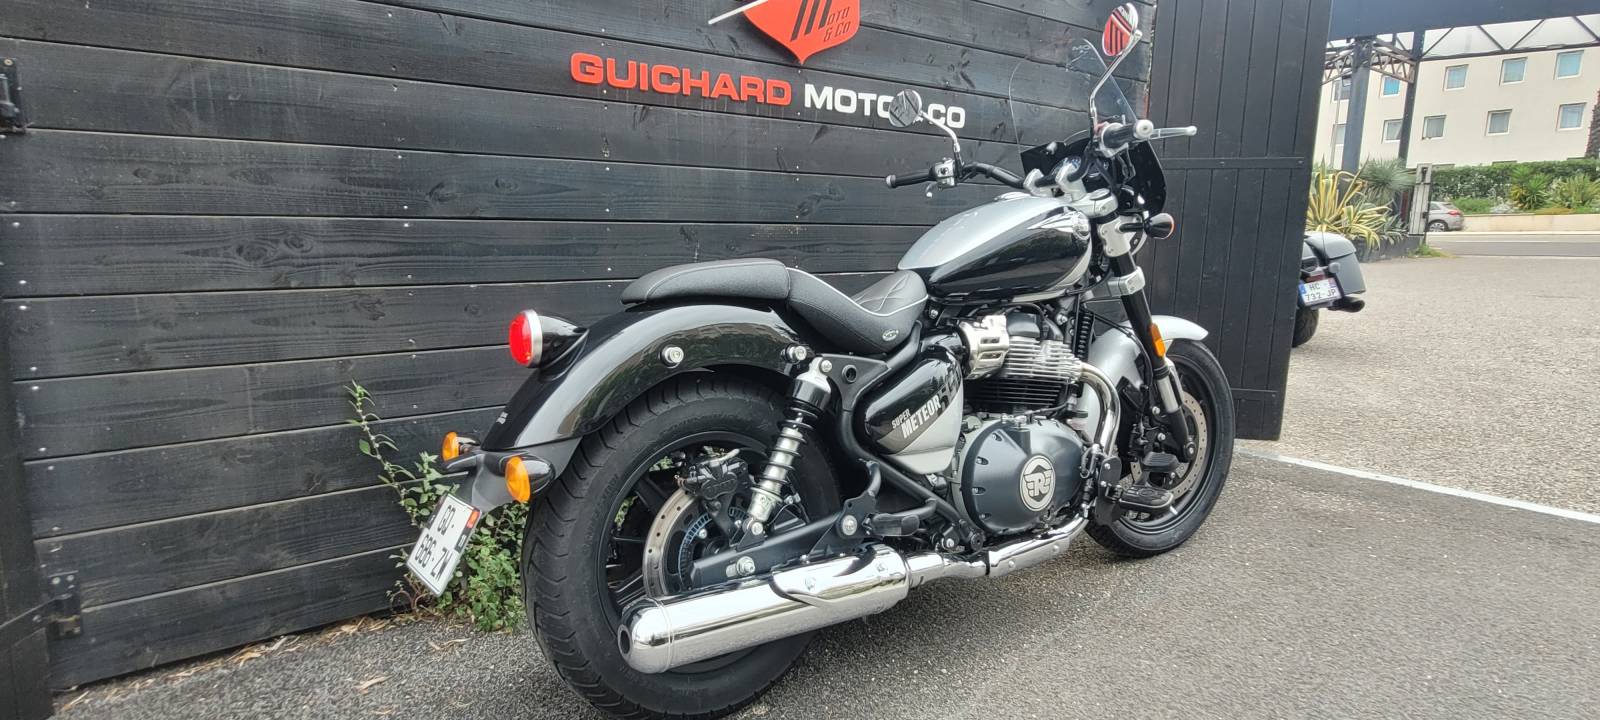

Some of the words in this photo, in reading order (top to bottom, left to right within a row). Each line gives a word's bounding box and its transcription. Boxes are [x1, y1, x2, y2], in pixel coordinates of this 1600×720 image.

[570, 52, 792, 106] GUICHARD
[927, 103, 966, 129] CO
[891, 408, 911, 429] SUPER
[901, 394, 941, 439] METEOR
